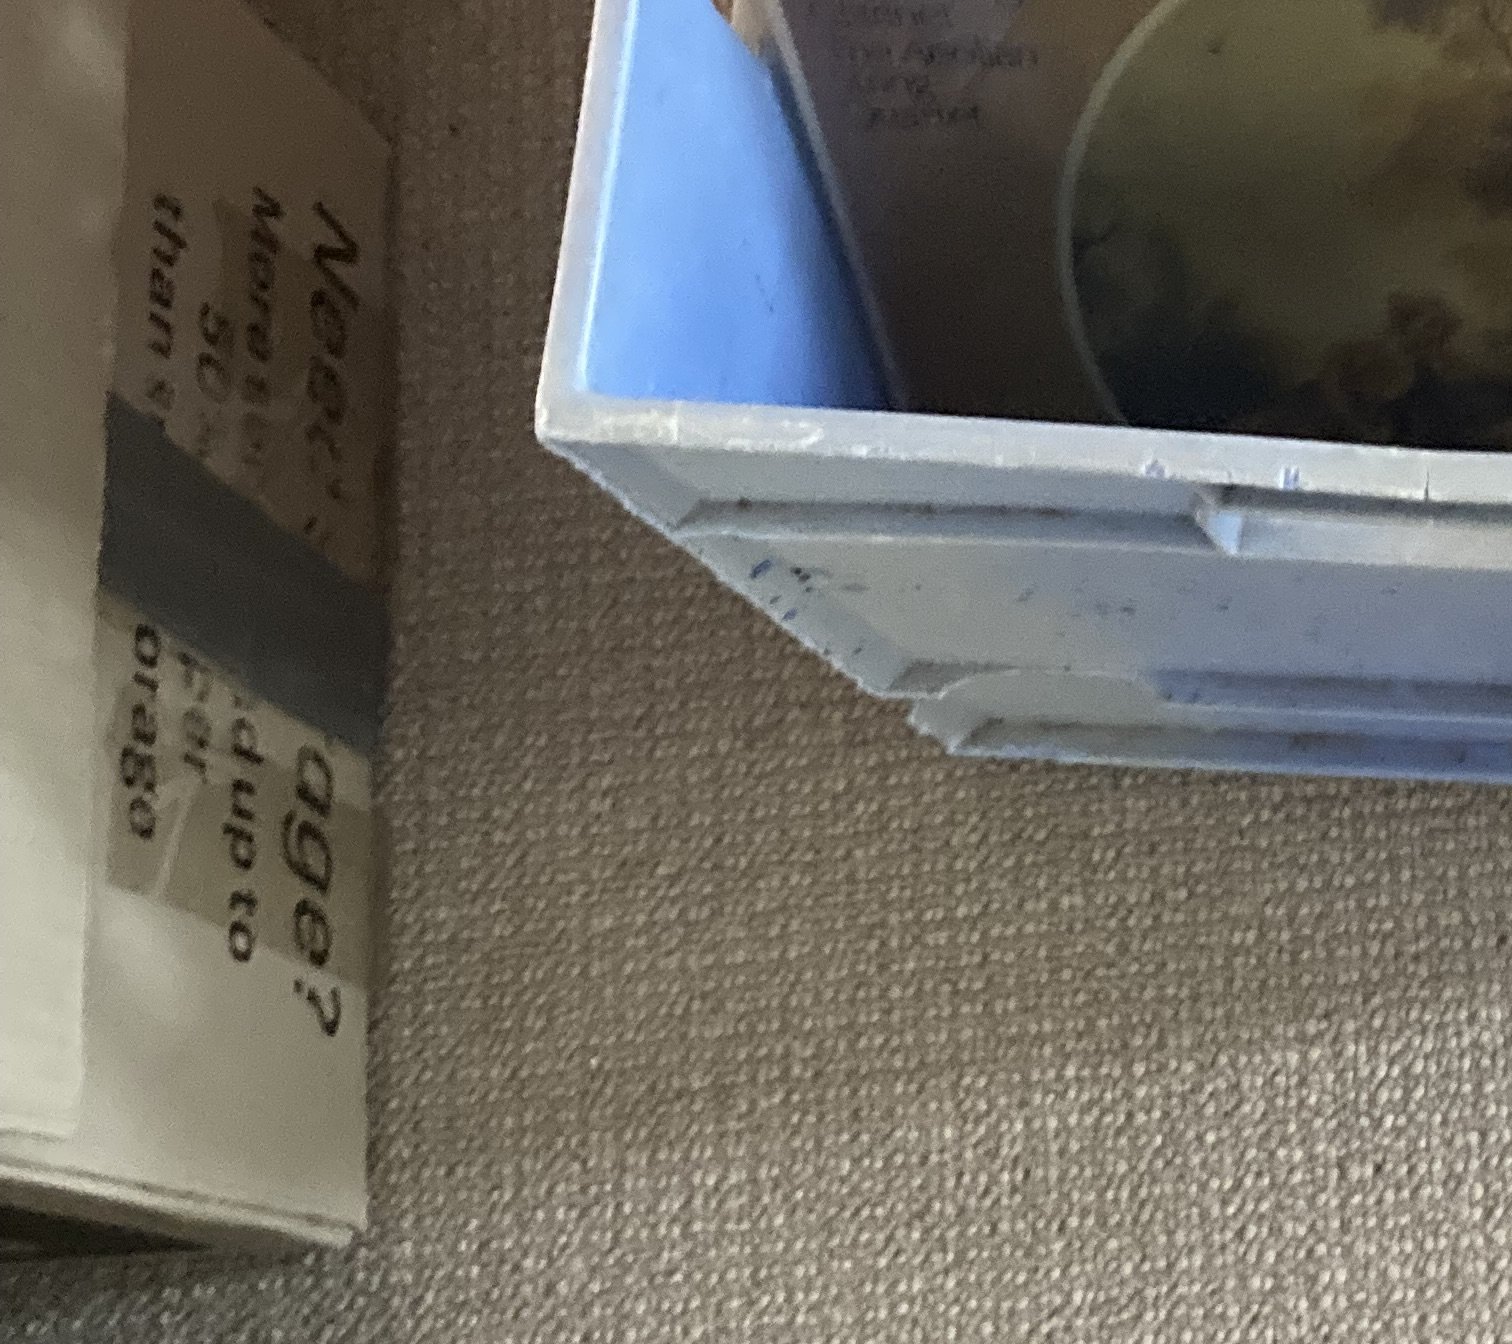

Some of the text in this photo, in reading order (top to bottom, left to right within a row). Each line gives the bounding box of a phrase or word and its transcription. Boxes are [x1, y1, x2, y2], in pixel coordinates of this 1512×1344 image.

[147, 193, 190, 360] than
[222, 777, 264, 874] up
[227, 889, 262, 965] to
